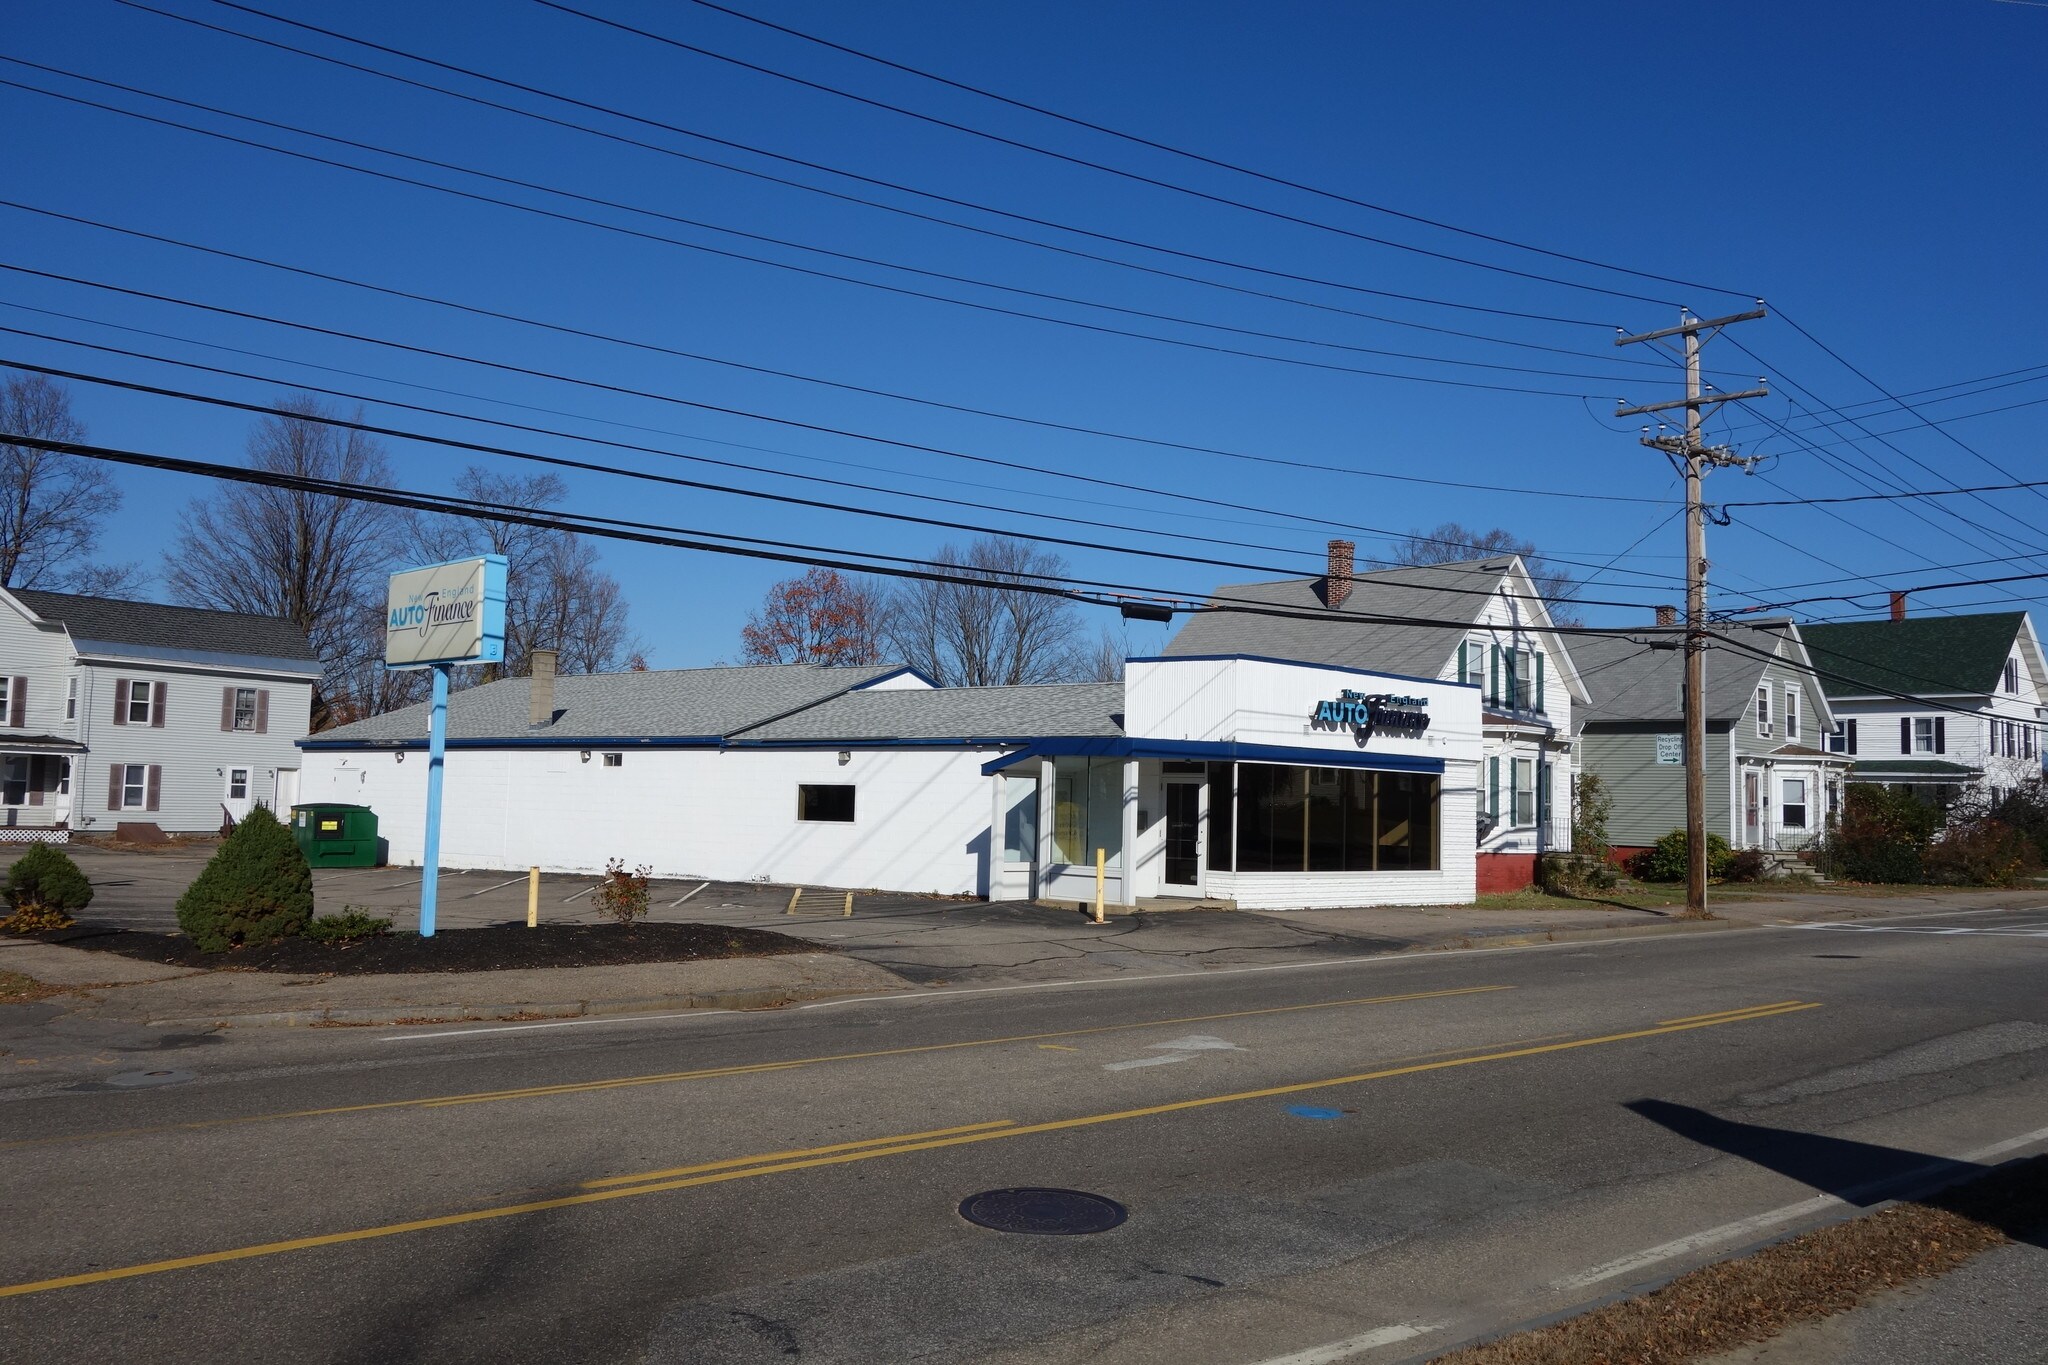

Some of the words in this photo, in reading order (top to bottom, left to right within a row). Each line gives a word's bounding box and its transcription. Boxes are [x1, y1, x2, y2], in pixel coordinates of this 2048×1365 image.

[408, 594, 423, 603] New
[441, 585, 474, 598] England
[389, 605, 424, 627] AUTO
[420, 591, 473, 637] Finance
[1344, 689, 1366, 700] New
[1387, 693, 1429, 707] England
[1318, 701, 1370, 725] AUTO
